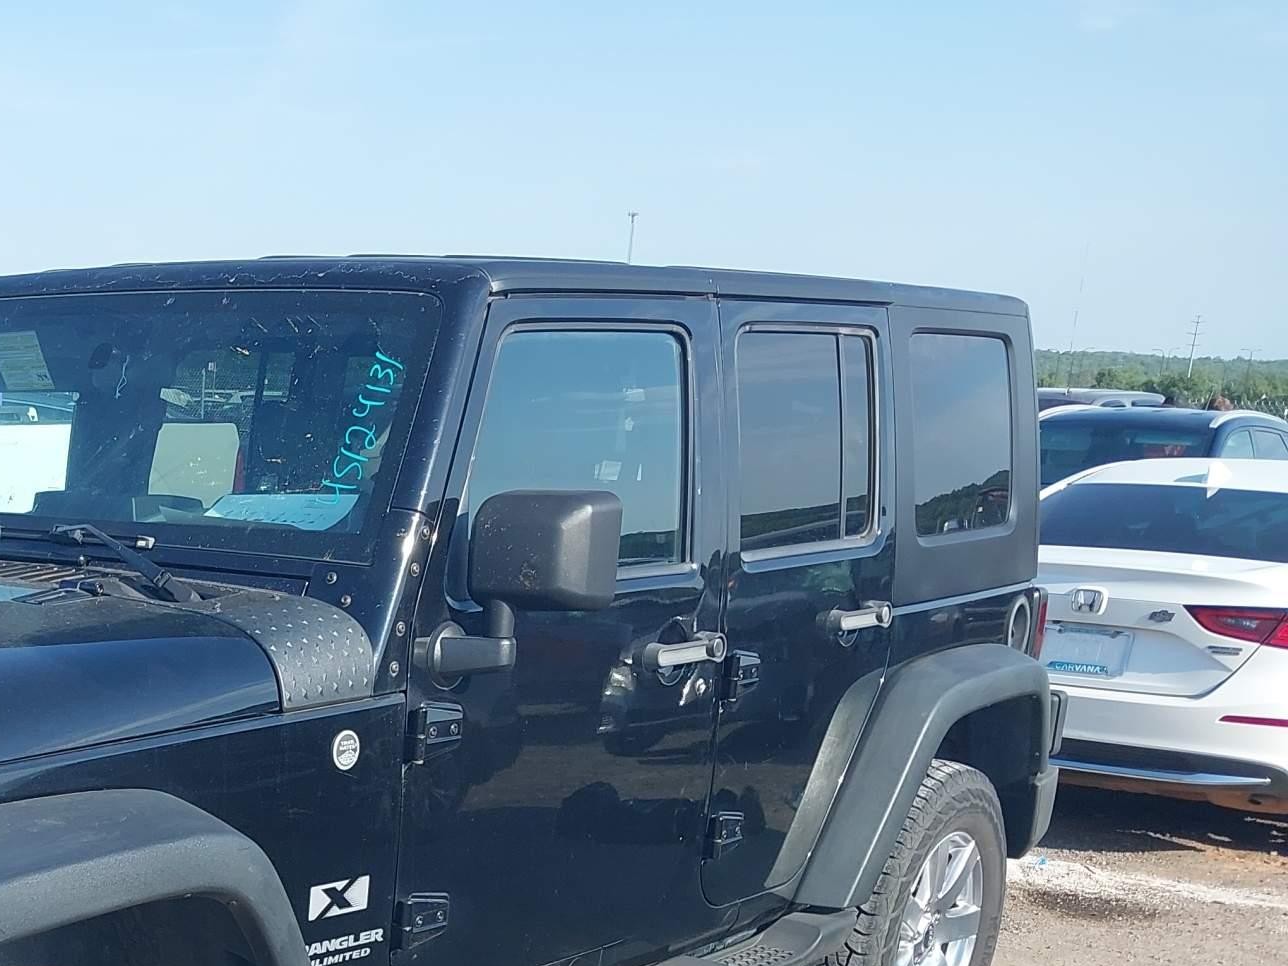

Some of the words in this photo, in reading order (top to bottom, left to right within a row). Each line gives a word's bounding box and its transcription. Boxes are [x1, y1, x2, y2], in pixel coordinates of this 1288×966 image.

[315, 350, 404, 506] 45124131
[1055, 662, 1102, 674] CARVANA
[305, 928, 384, 957] ANGLER
